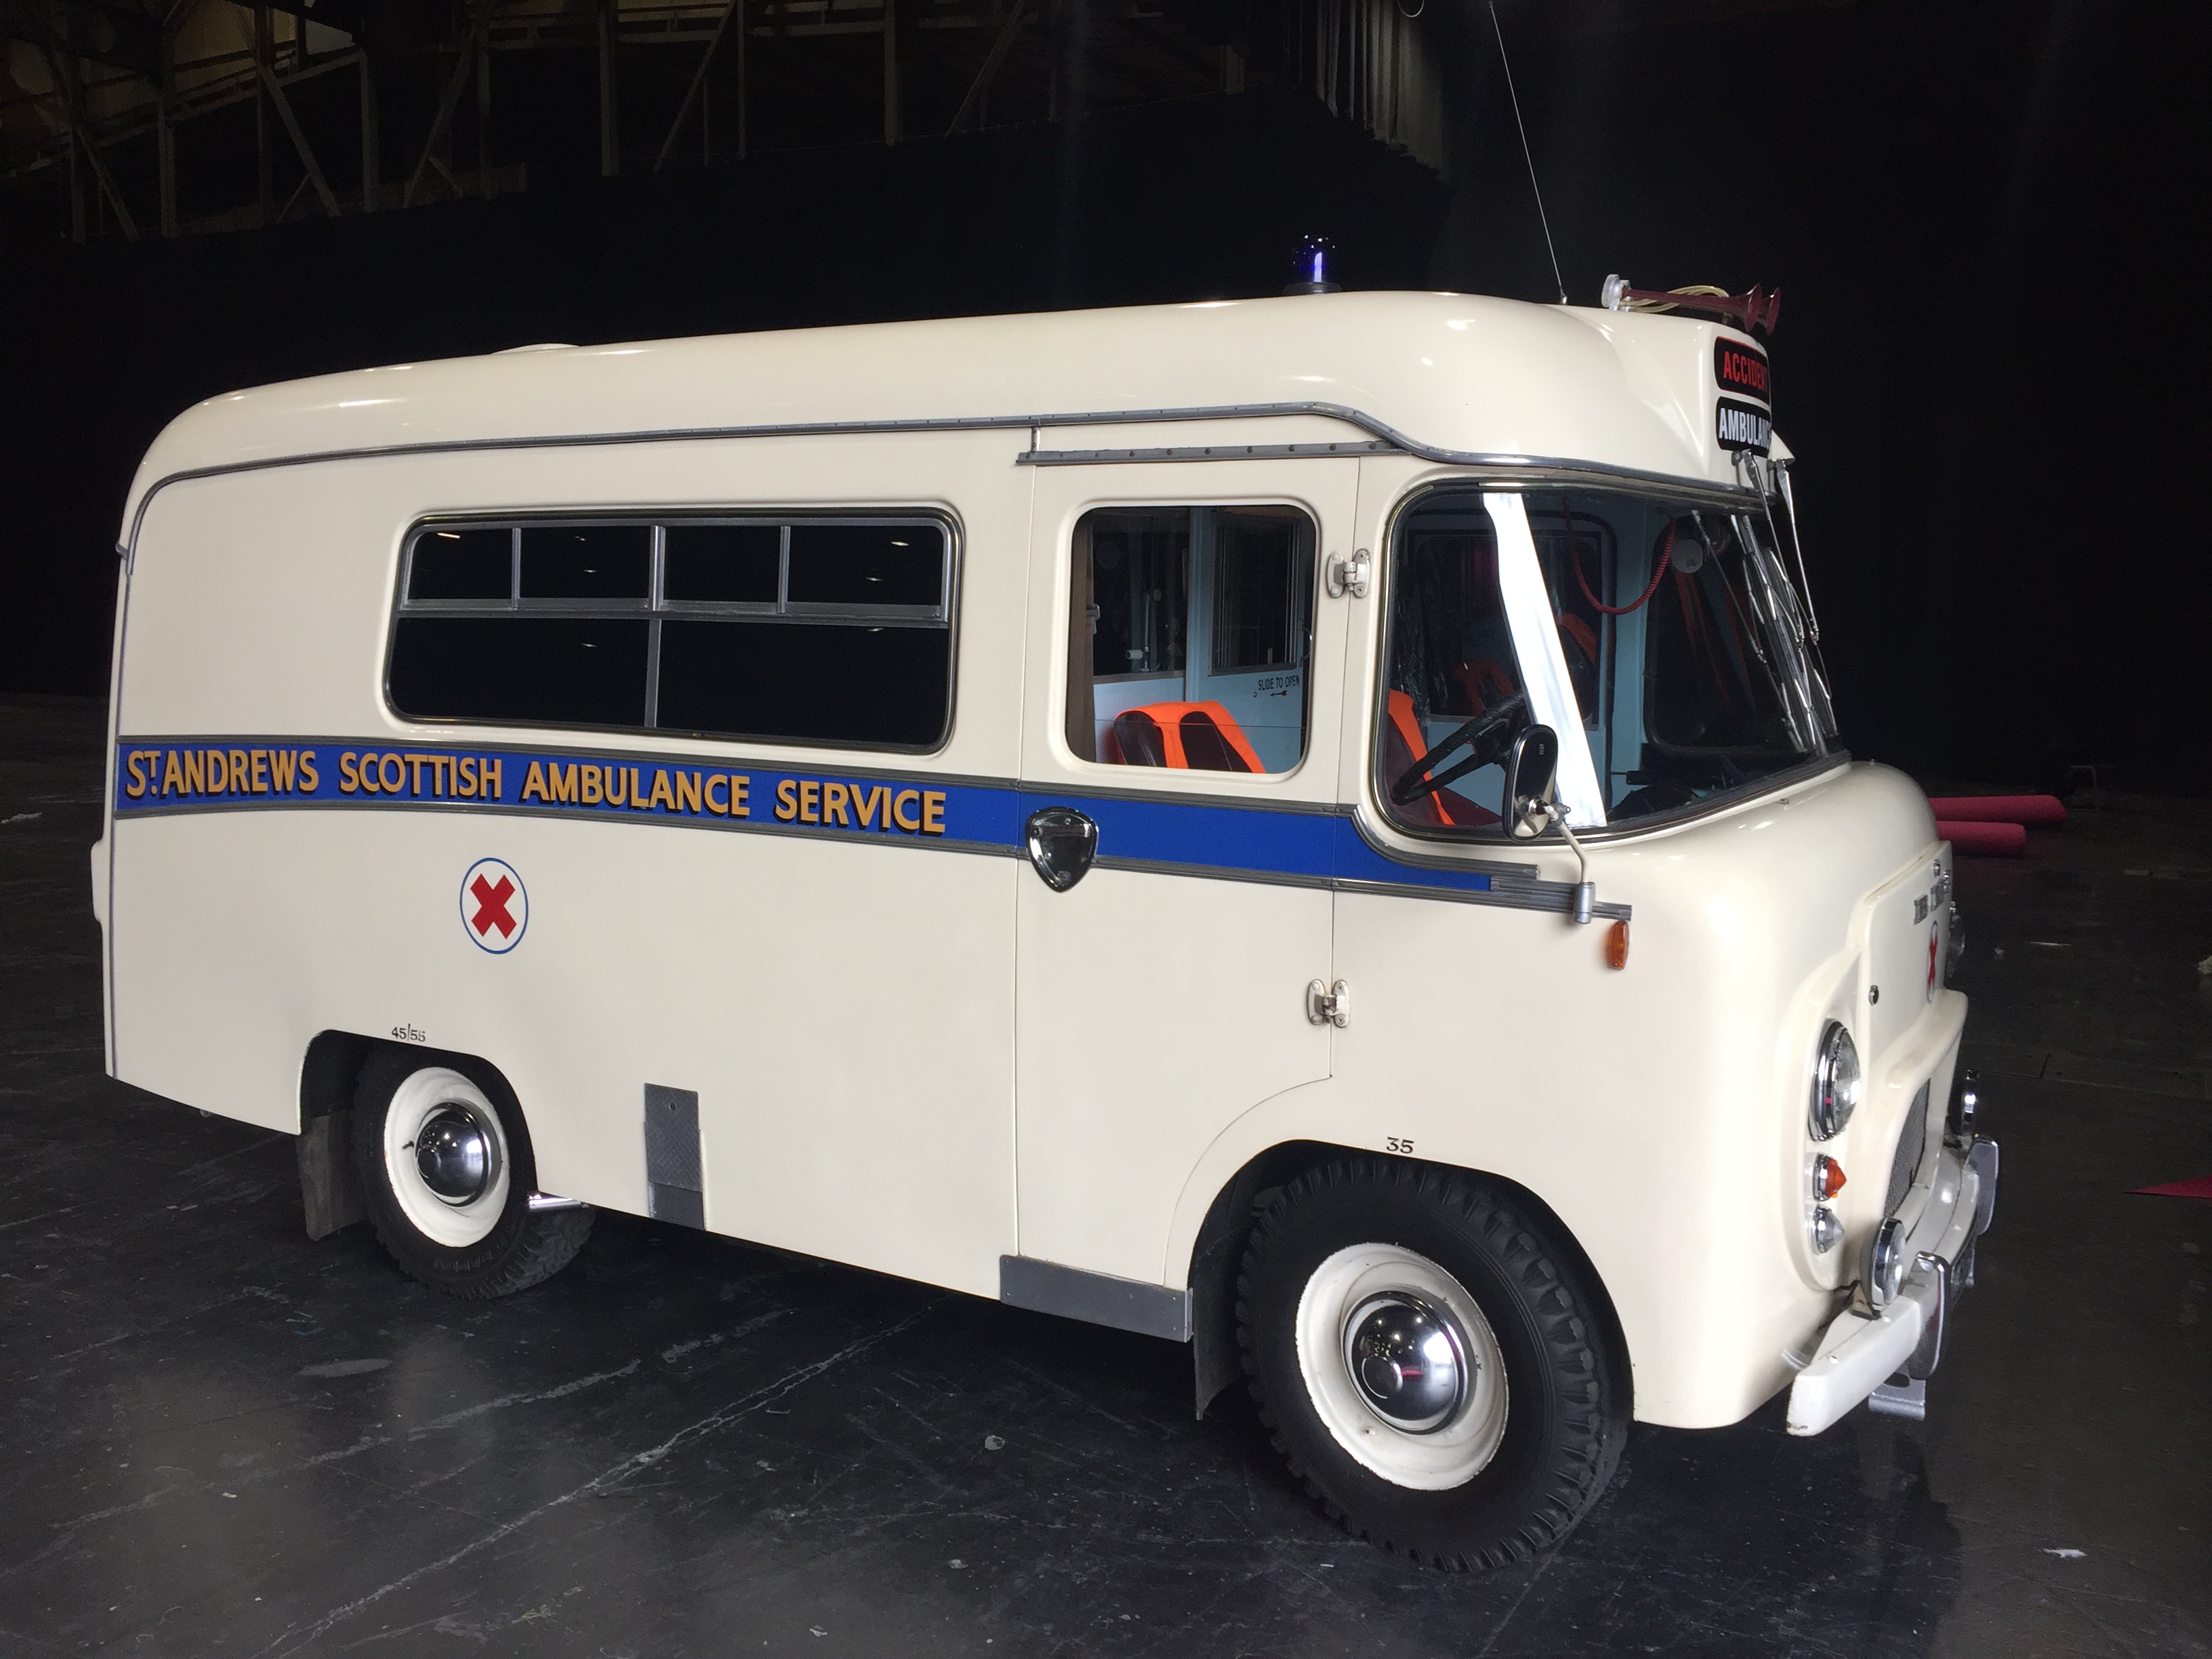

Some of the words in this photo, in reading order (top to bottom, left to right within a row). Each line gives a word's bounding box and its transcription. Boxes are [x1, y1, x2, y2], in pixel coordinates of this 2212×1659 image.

[1723, 350, 1768, 393] ACCIDENT
[1719, 407, 1771, 449] AMBULANC
[1258, 678, 1274, 691] SLIDE
[1275, 677, 1284, 689] TO
[1285, 675, 1300, 687] OPEN
[339, 752, 502, 800] SCOTTISH
[521, 761, 750, 816] AMBULANCE
[774, 779, 947, 836] SERVICE
[1386, 1136, 1414, 1154] 35
